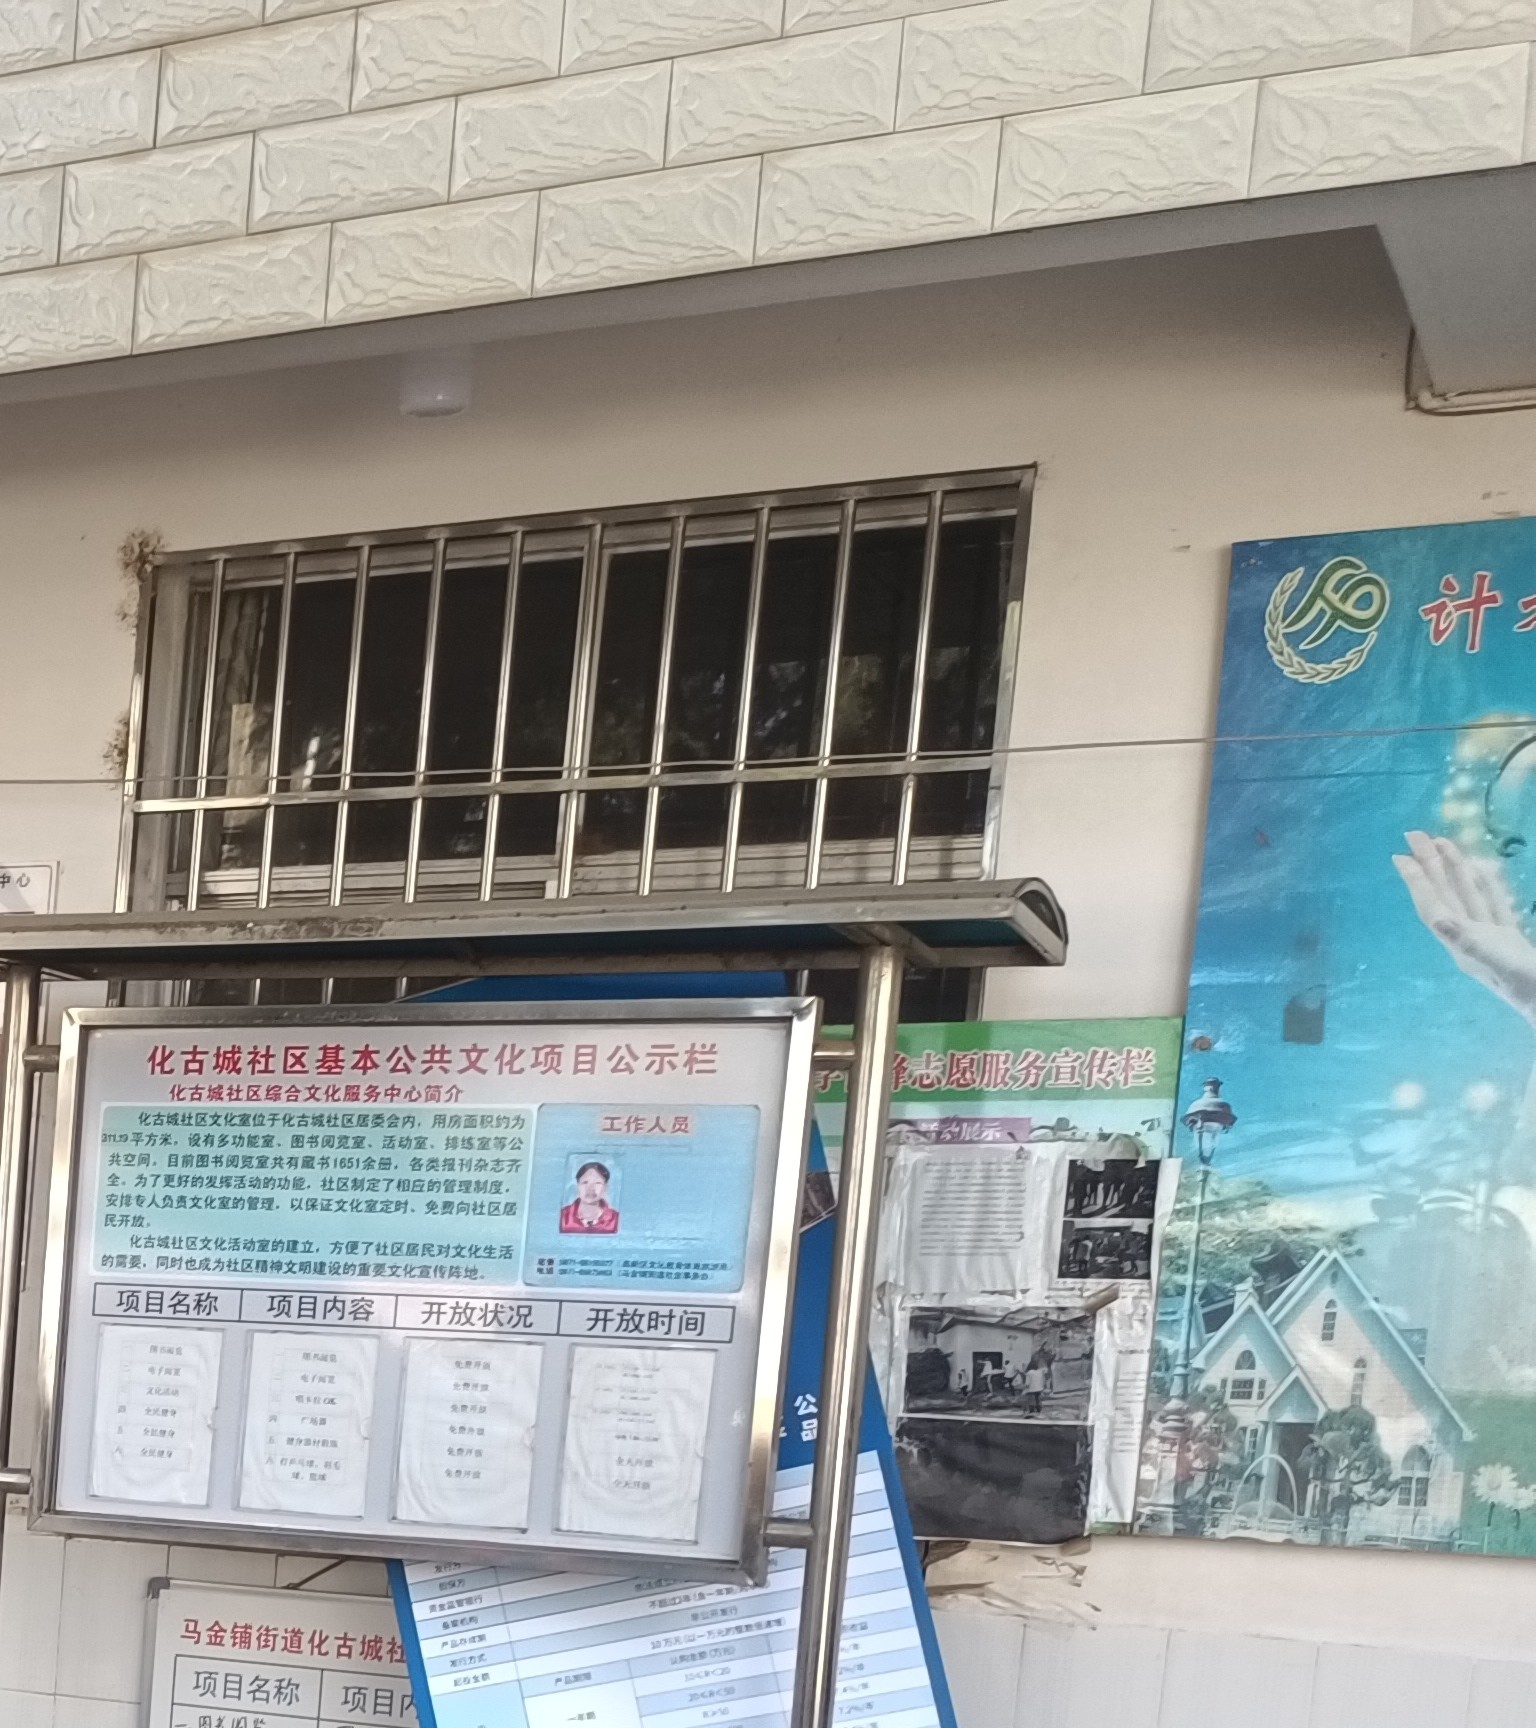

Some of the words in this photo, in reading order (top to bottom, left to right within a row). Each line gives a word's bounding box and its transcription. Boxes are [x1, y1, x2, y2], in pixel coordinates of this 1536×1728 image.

[1419, 570, 1536, 655] 计
[146, 1043, 719, 1077] 化古城社区基本公共文化项目公示栏
[168, 1083, 465, 1104] 化古城社区综合文化服务中心简介
[602, 1114, 690, 1134] 工作人员
[115, 1289, 219, 1317] 项目名称
[267, 1294, 375, 1322] 项目内容
[420, 1301, 534, 1329] 开放状况
[586, 1307, 707, 1337] 开放时间
[180, 1618, 407, 1664] 马金铺街道化古城社
[192, 1671, 301, 1706] 项目名称
